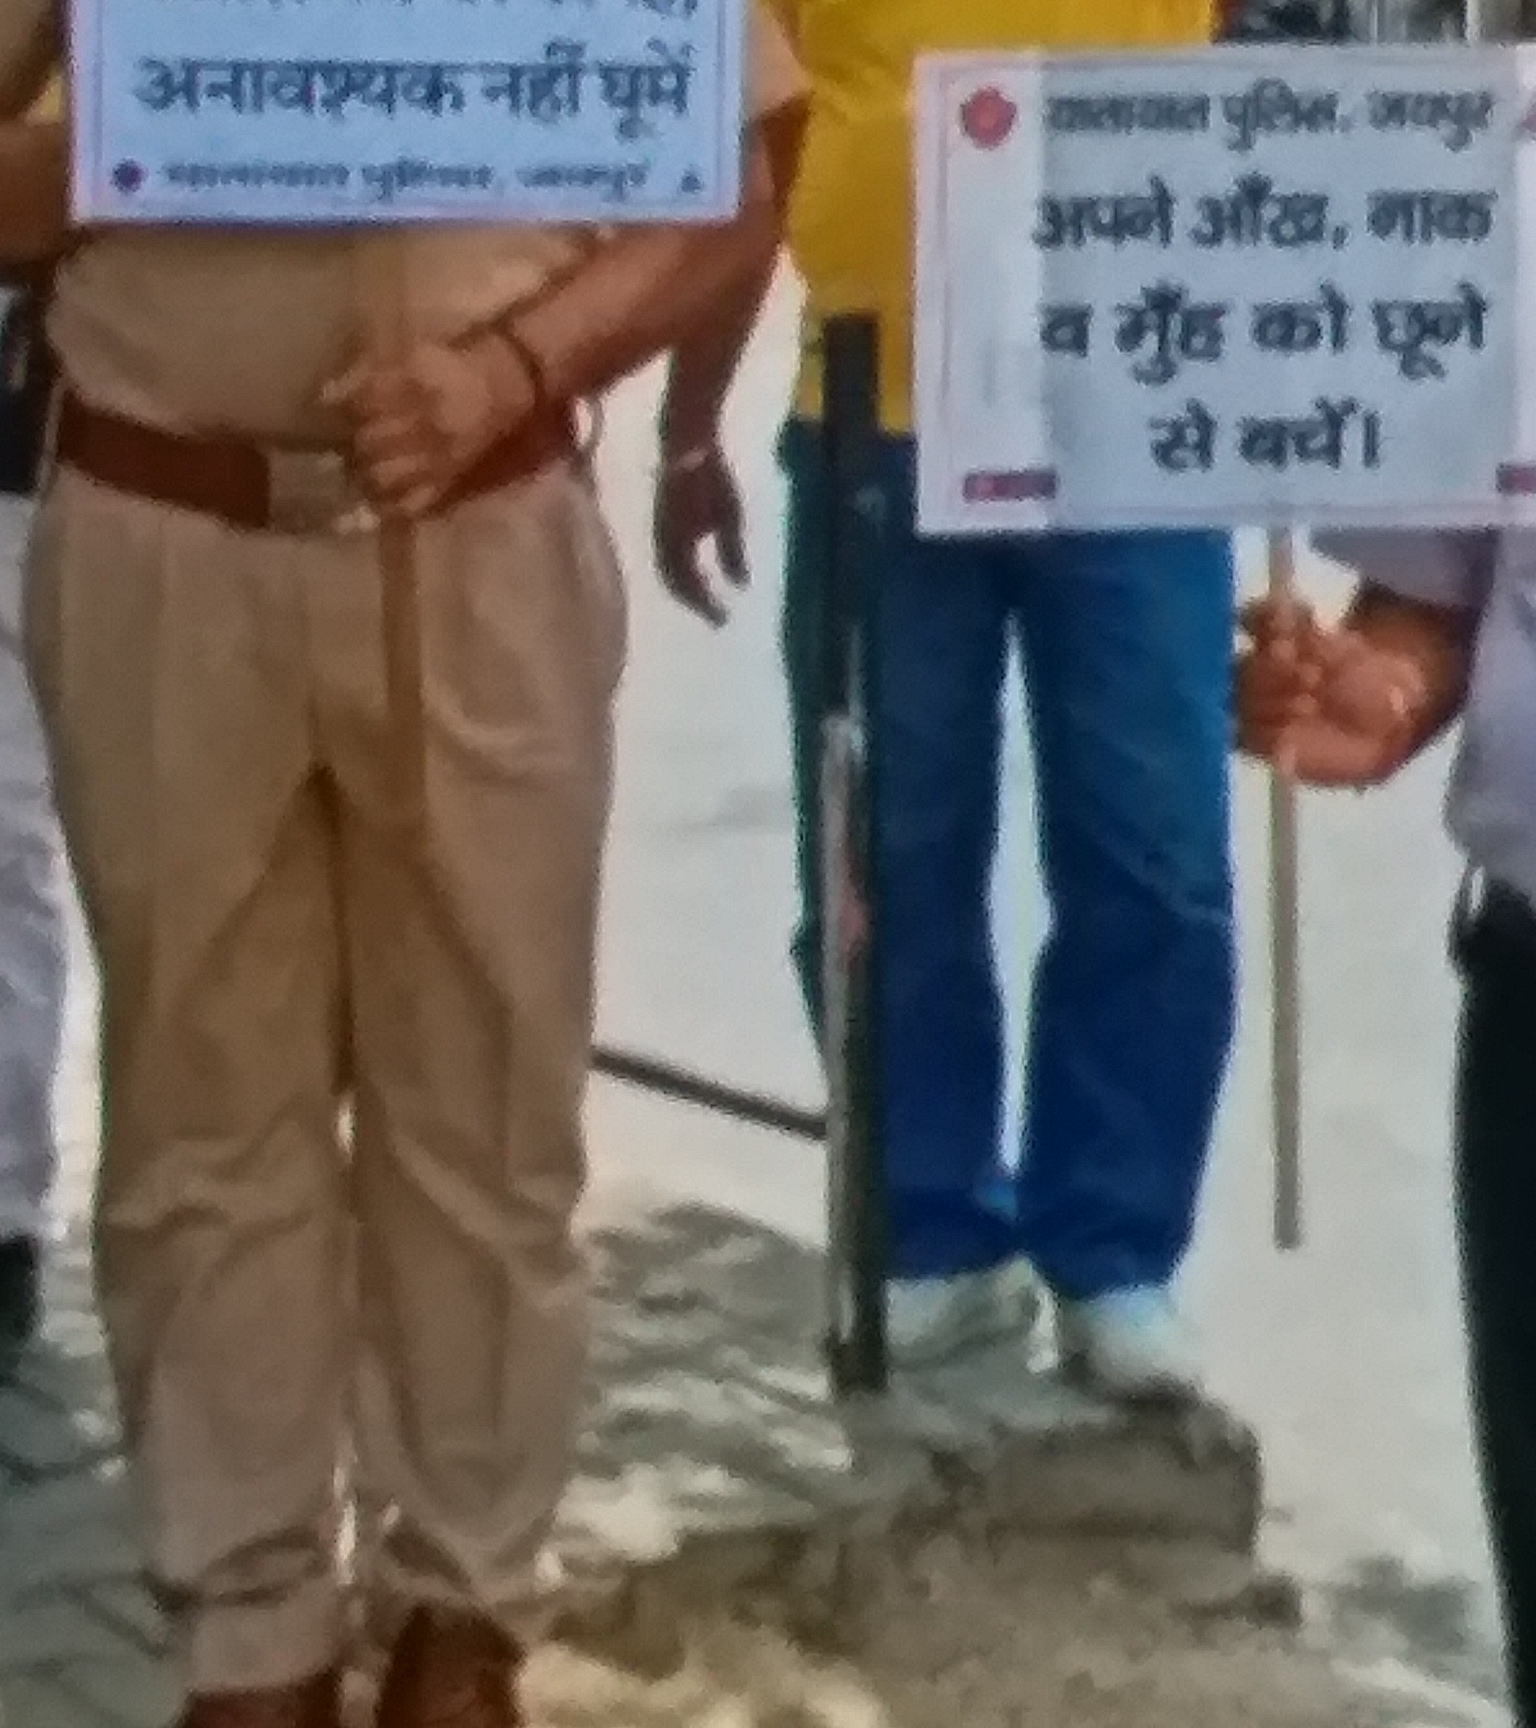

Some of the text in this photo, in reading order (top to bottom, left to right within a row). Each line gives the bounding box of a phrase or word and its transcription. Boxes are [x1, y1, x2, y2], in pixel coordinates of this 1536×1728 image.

[133, 36, 697, 142] अनावश्यक नहीं घूमें
[1033, 175, 1175, 250] अपने
[1366, 187, 1500, 246] नाक
[1037, 302, 1093, 359] व
[1251, 277, 1352, 355] को
[1371, 280, 1489, 381] छूने
[1148, 397, 1219, 472] से
